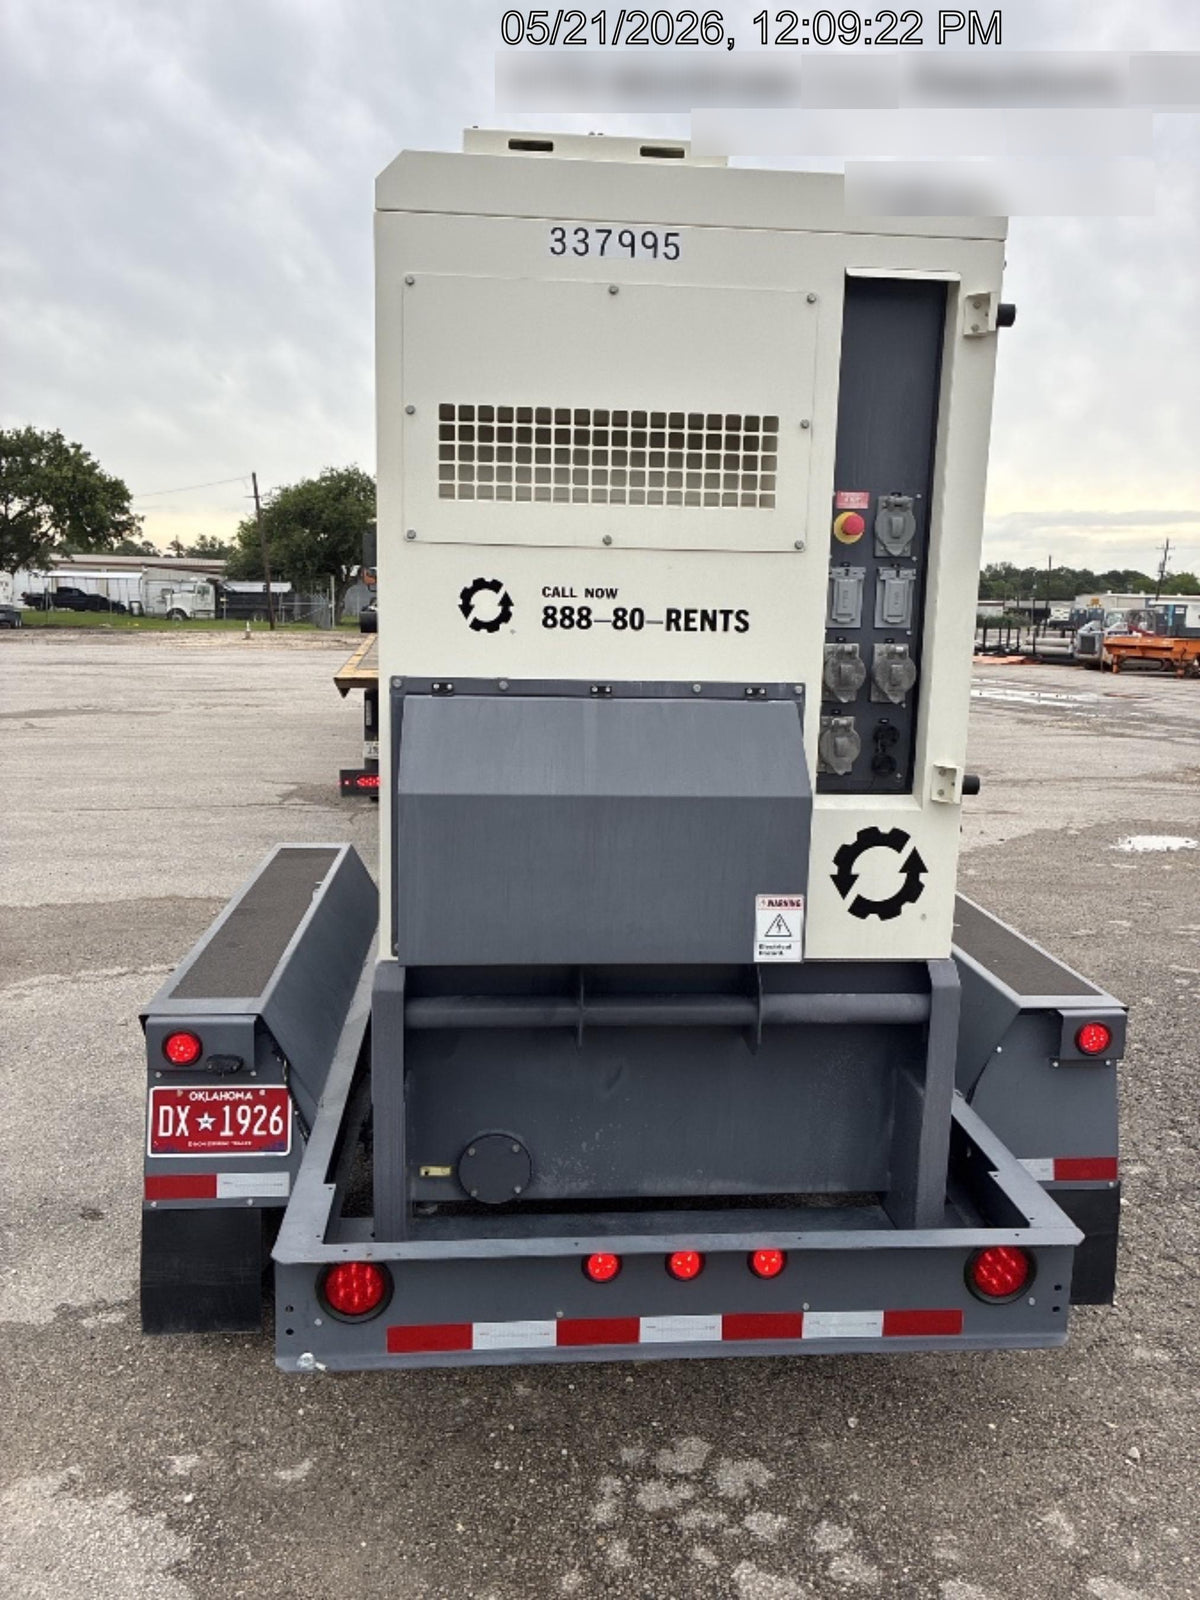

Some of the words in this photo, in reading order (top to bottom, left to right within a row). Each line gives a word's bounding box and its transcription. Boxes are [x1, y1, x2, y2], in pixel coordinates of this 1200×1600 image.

[549, 226, 680, 261] 337995
[541, 586, 577, 599] CALL
[584, 587, 619, 600] NOW
[189, 1091, 253, 1101] OKLAHOMA
[158, 1105, 191, 1137] DX
[219, 1104, 284, 1137] 1926
